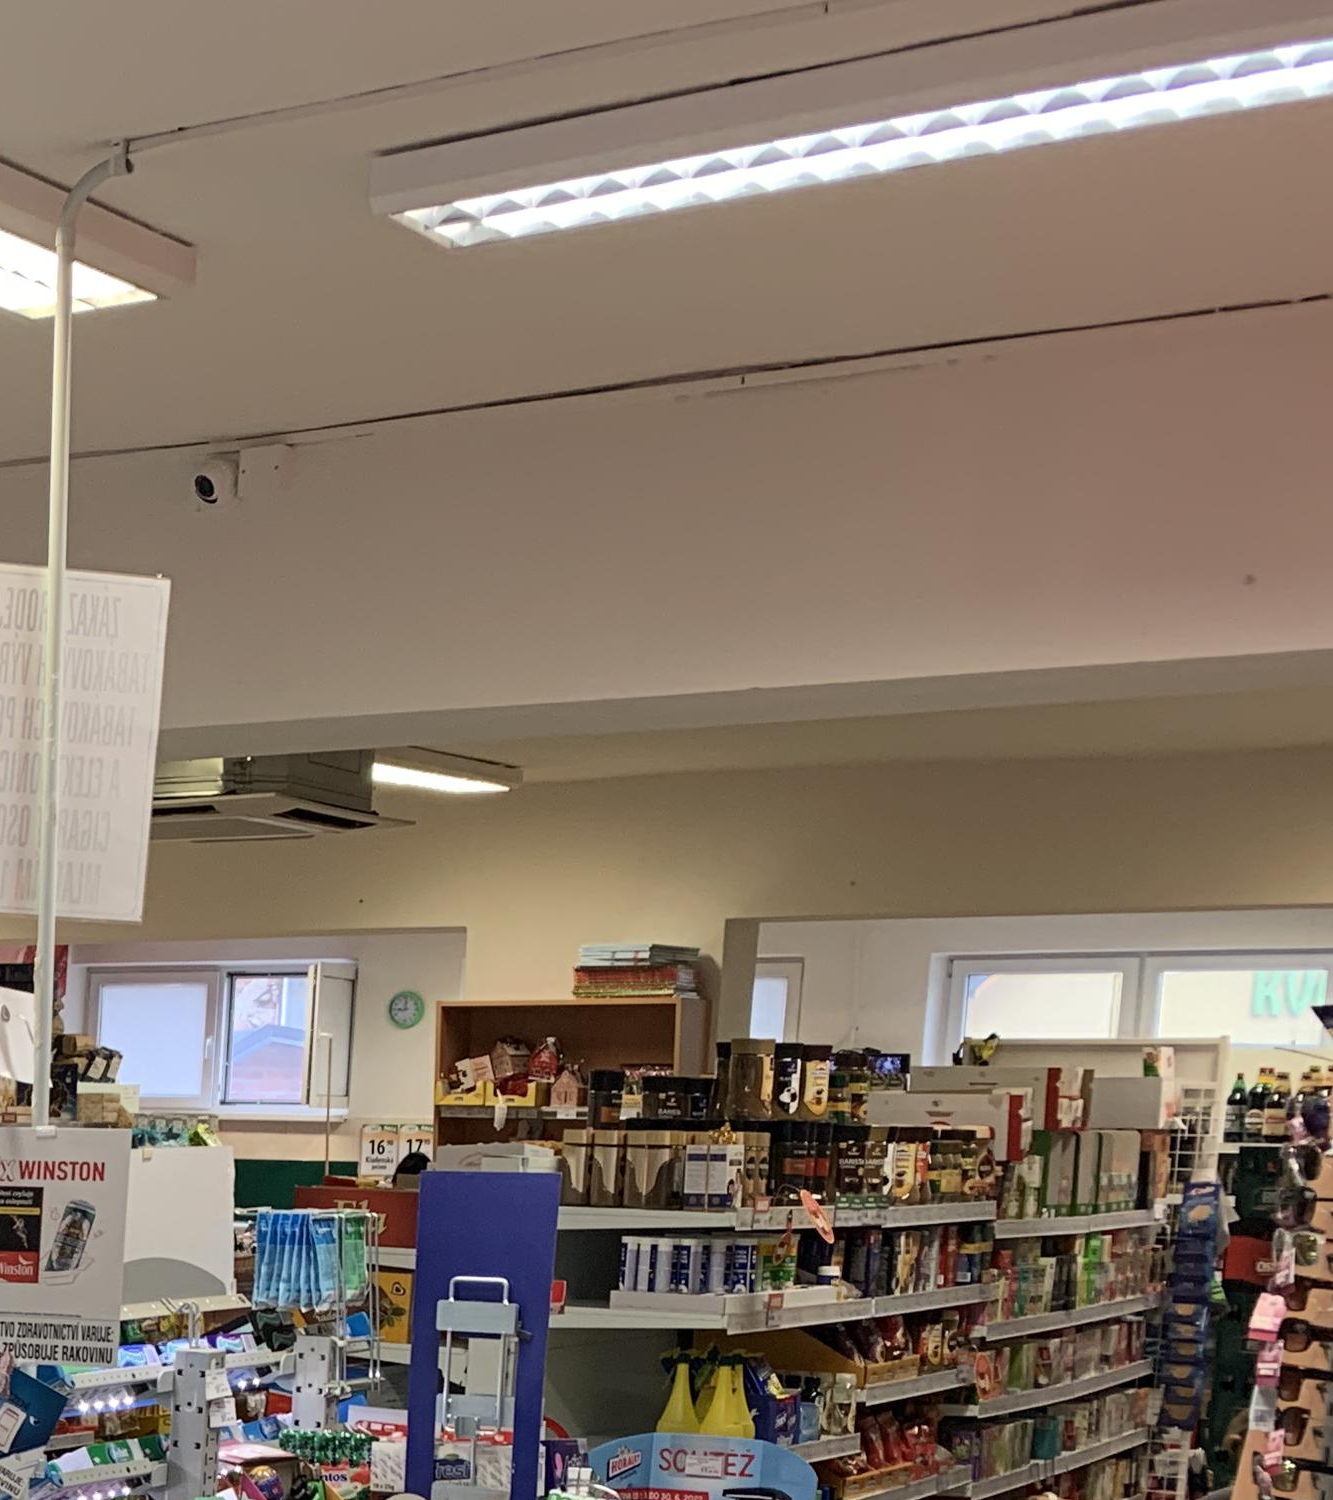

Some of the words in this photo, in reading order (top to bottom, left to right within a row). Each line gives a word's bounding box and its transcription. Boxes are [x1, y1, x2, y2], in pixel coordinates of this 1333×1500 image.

[369, 1139, 386, 1155] 16
[19, 1160, 106, 1182] WINSTON
[16, 1321, 80, 1342] ZDRAVOTNICTVÍ
[81, 1325, 114, 1344] VARUJE:
[2, 1339, 58, 1361] ZPŮSOBUJE
[61, 1345, 113, 1364] RAKOVINU
[658, 1447, 755, 1478] SOĚŽ
